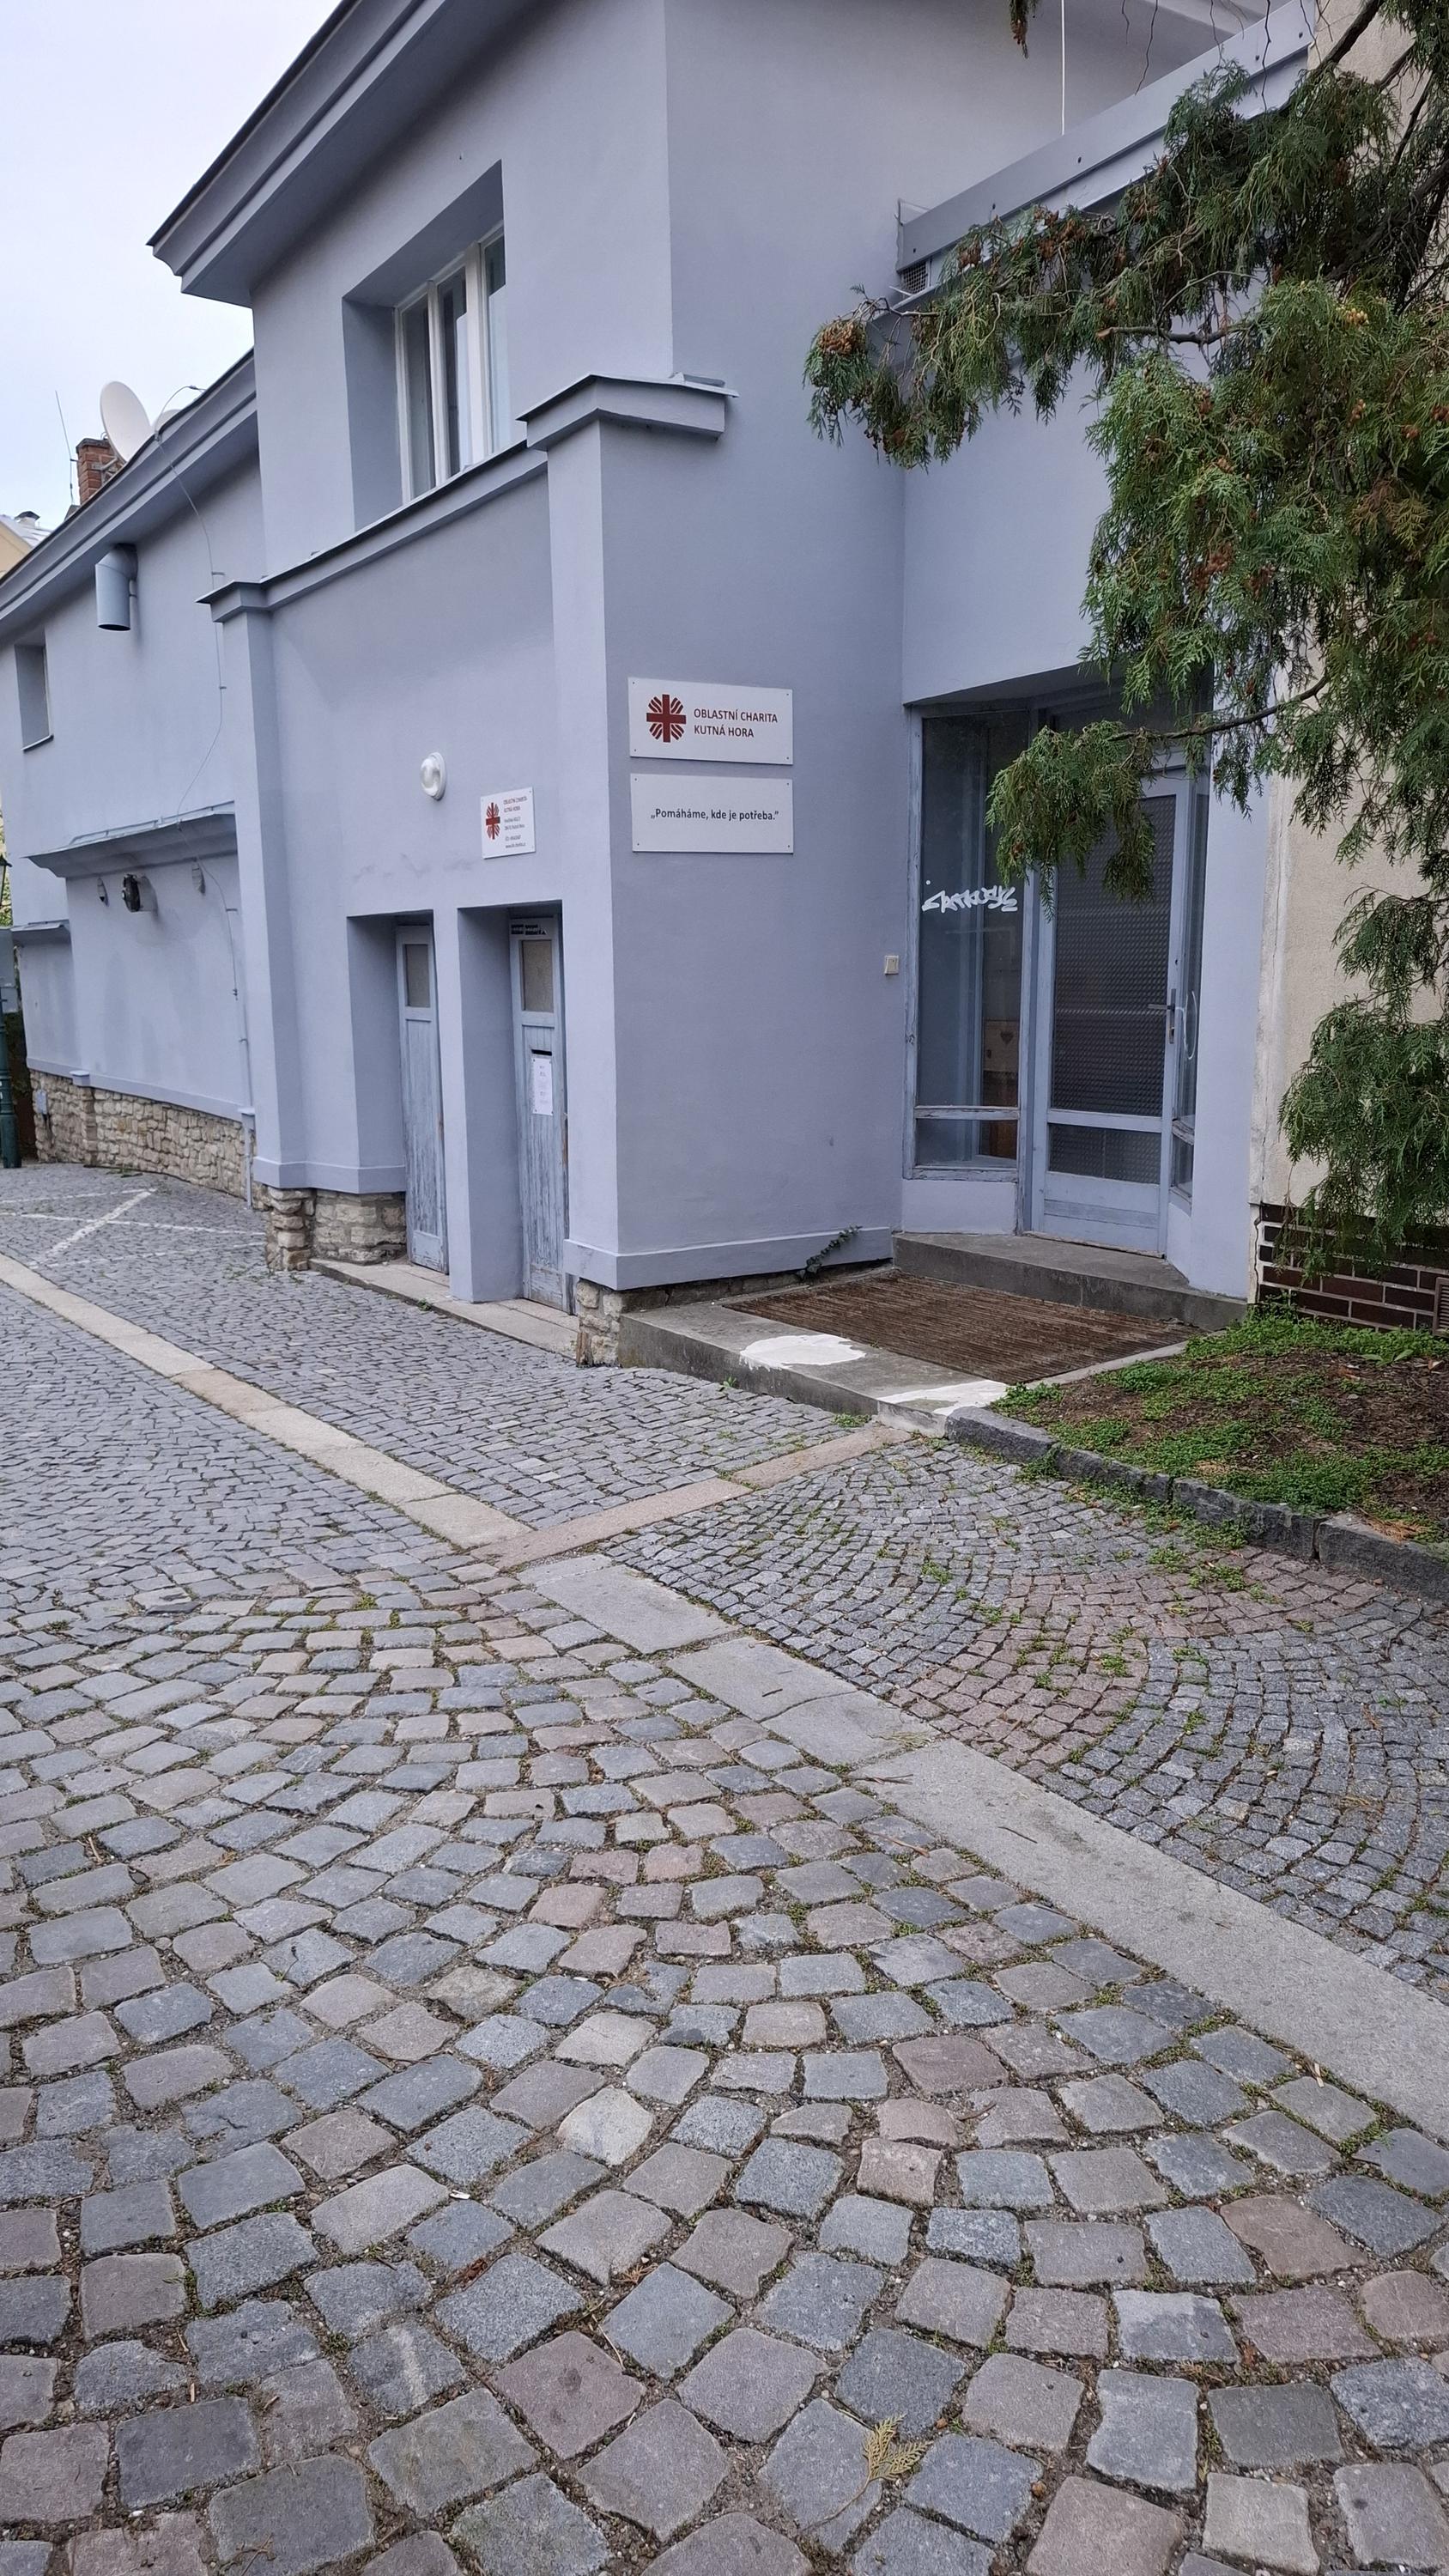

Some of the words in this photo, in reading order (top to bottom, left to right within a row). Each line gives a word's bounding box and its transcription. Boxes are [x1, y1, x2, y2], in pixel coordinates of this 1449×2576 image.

[694, 708, 738, 721] OBLASTNÍ
[740, 712, 778, 723] CHARITA
[694, 725, 725, 736] KUTNÁ
[728, 727, 755, 738] HORA
[711, 810, 727, 819] kde
[729, 811, 737, 821] je
